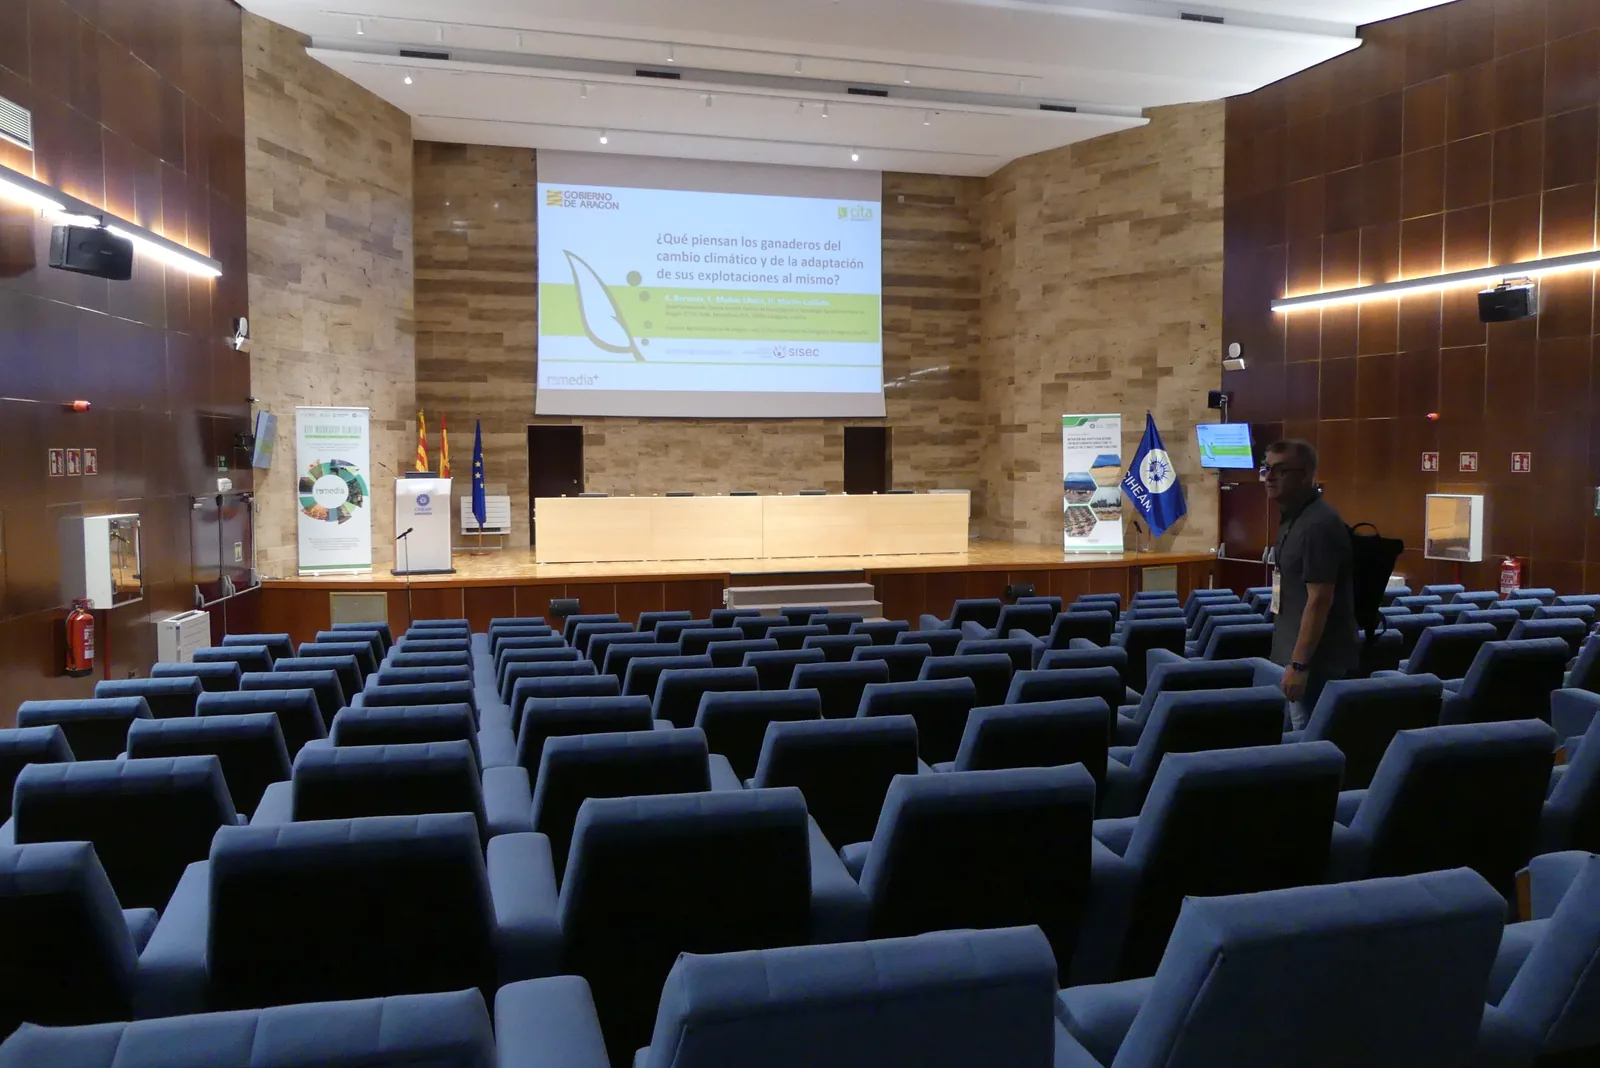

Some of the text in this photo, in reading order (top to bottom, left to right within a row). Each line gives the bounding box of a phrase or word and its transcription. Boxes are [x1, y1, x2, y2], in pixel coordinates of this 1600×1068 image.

[563, 190, 612, 201] GOBIERNO
[563, 199, 576, 208] DE
[850, 204, 873, 219] cita
[656, 232, 842, 252] ¿Qué piensan los ganaderos del
[656, 251, 864, 270] cambio climático y de la adaptación
[656, 268, 841, 286] de sus explotaciones al mismo?
